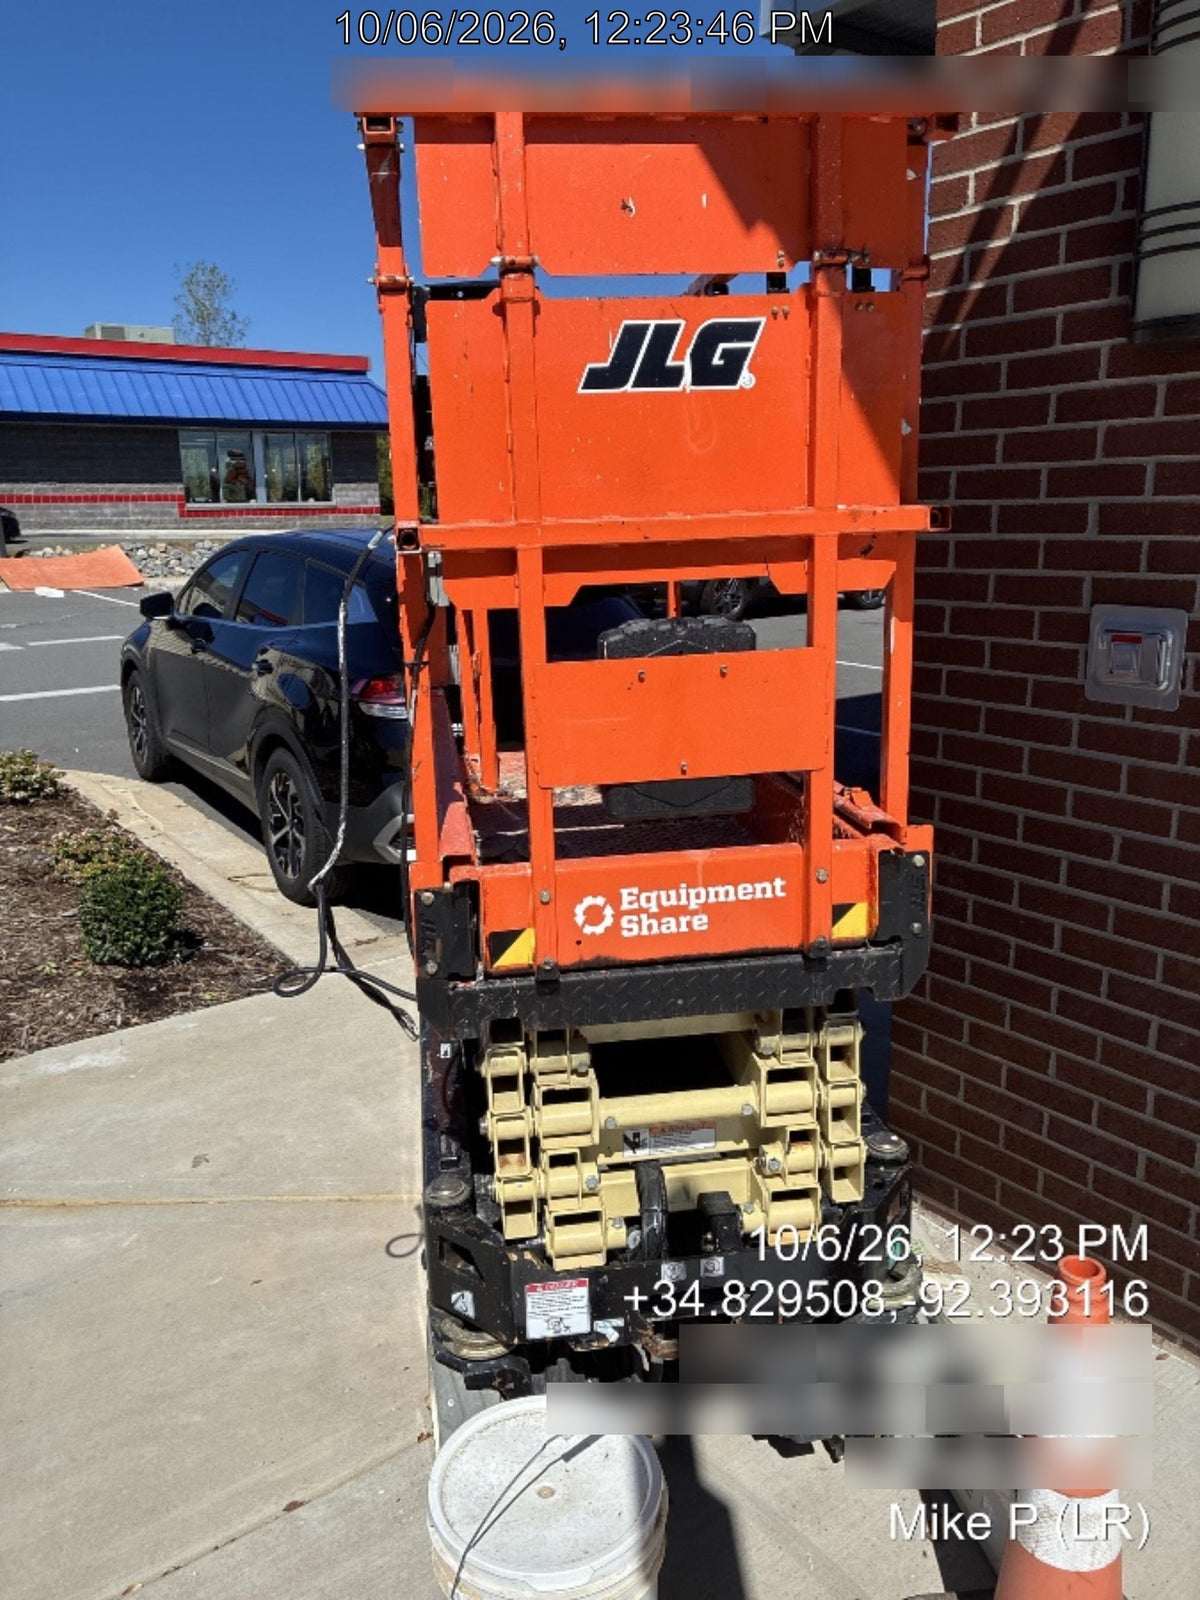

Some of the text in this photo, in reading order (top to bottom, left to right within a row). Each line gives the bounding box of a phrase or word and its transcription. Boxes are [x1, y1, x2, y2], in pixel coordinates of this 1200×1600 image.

[577, 317, 767, 393] JLG
[620, 877, 786, 912] Equipment
[620, 913, 709, 938] Share
